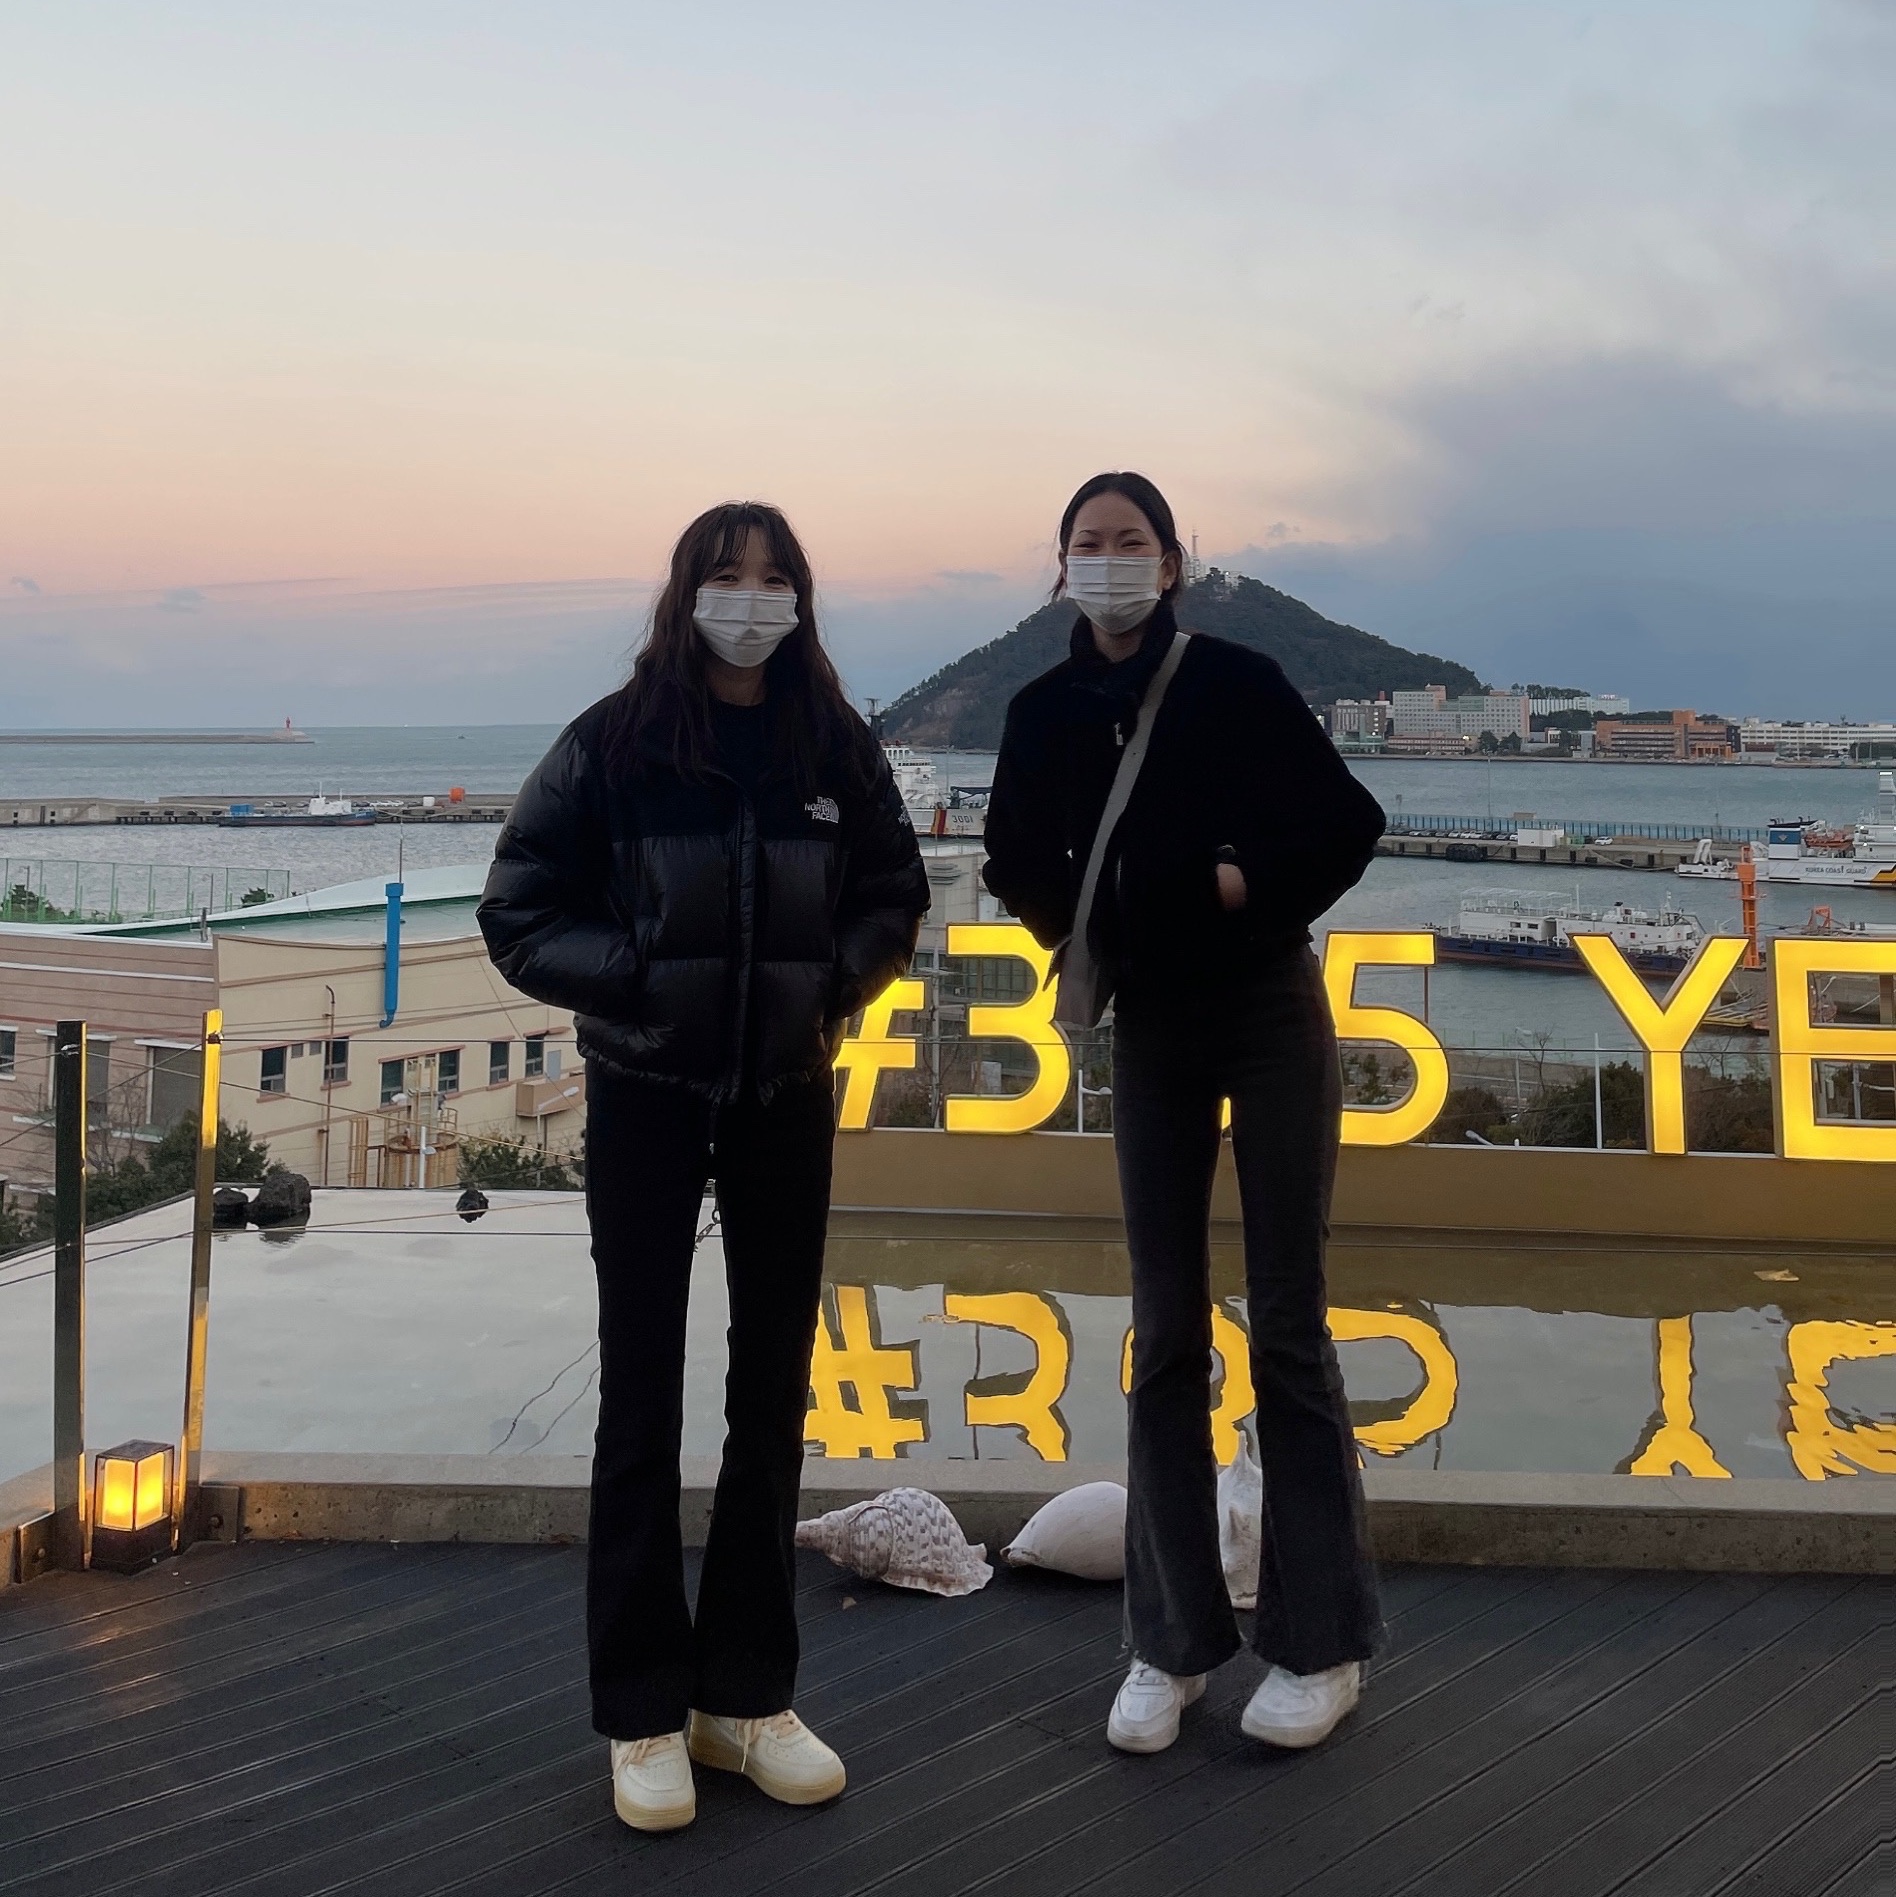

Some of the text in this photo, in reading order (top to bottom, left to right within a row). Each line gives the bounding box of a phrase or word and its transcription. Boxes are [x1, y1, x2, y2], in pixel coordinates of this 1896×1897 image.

[816, 795, 831, 805] THE
[804, 802, 831, 815] NORTH
[811, 811, 831, 821] FACE
[1825, 866, 1844, 874] COAST
[833, 923, 1450, 1147] #35
